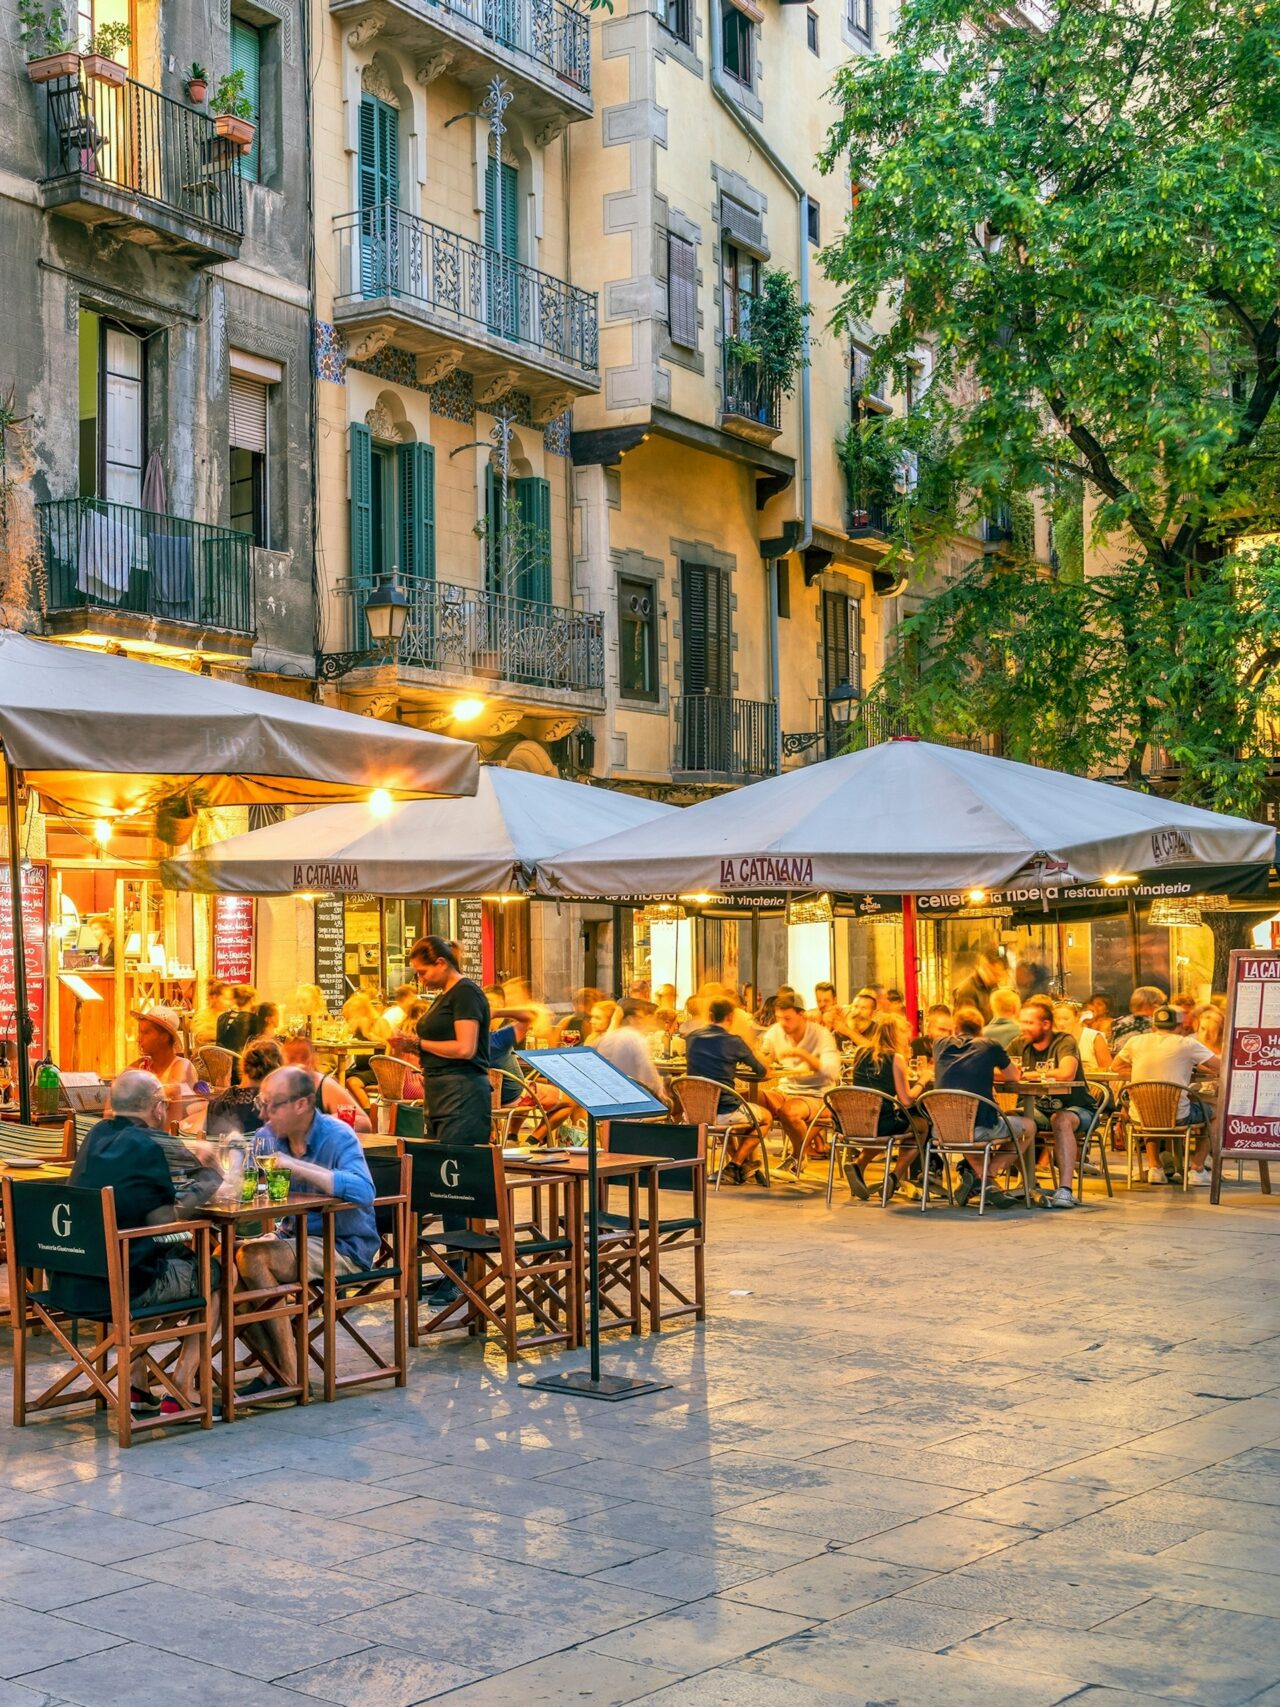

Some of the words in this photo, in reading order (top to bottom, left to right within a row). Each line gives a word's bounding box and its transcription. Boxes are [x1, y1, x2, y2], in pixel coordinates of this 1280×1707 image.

[1151, 834, 1162, 858] LA
[293, 864, 303, 885] LA
[306, 864, 359, 885] CATALANA
[720, 860, 735, 882] LA
[740, 857, 813, 881] CATALANA
[737, 895, 784, 906] vinateria
[918, 894, 966, 908] celler
[1064, 886, 1129, 898] restaurant
[1132, 882, 1191, 895] vinateria
[1245, 961, 1259, 978] LA
[440, 1159, 460, 1187] G
[51, 1203, 73, 1237] G
